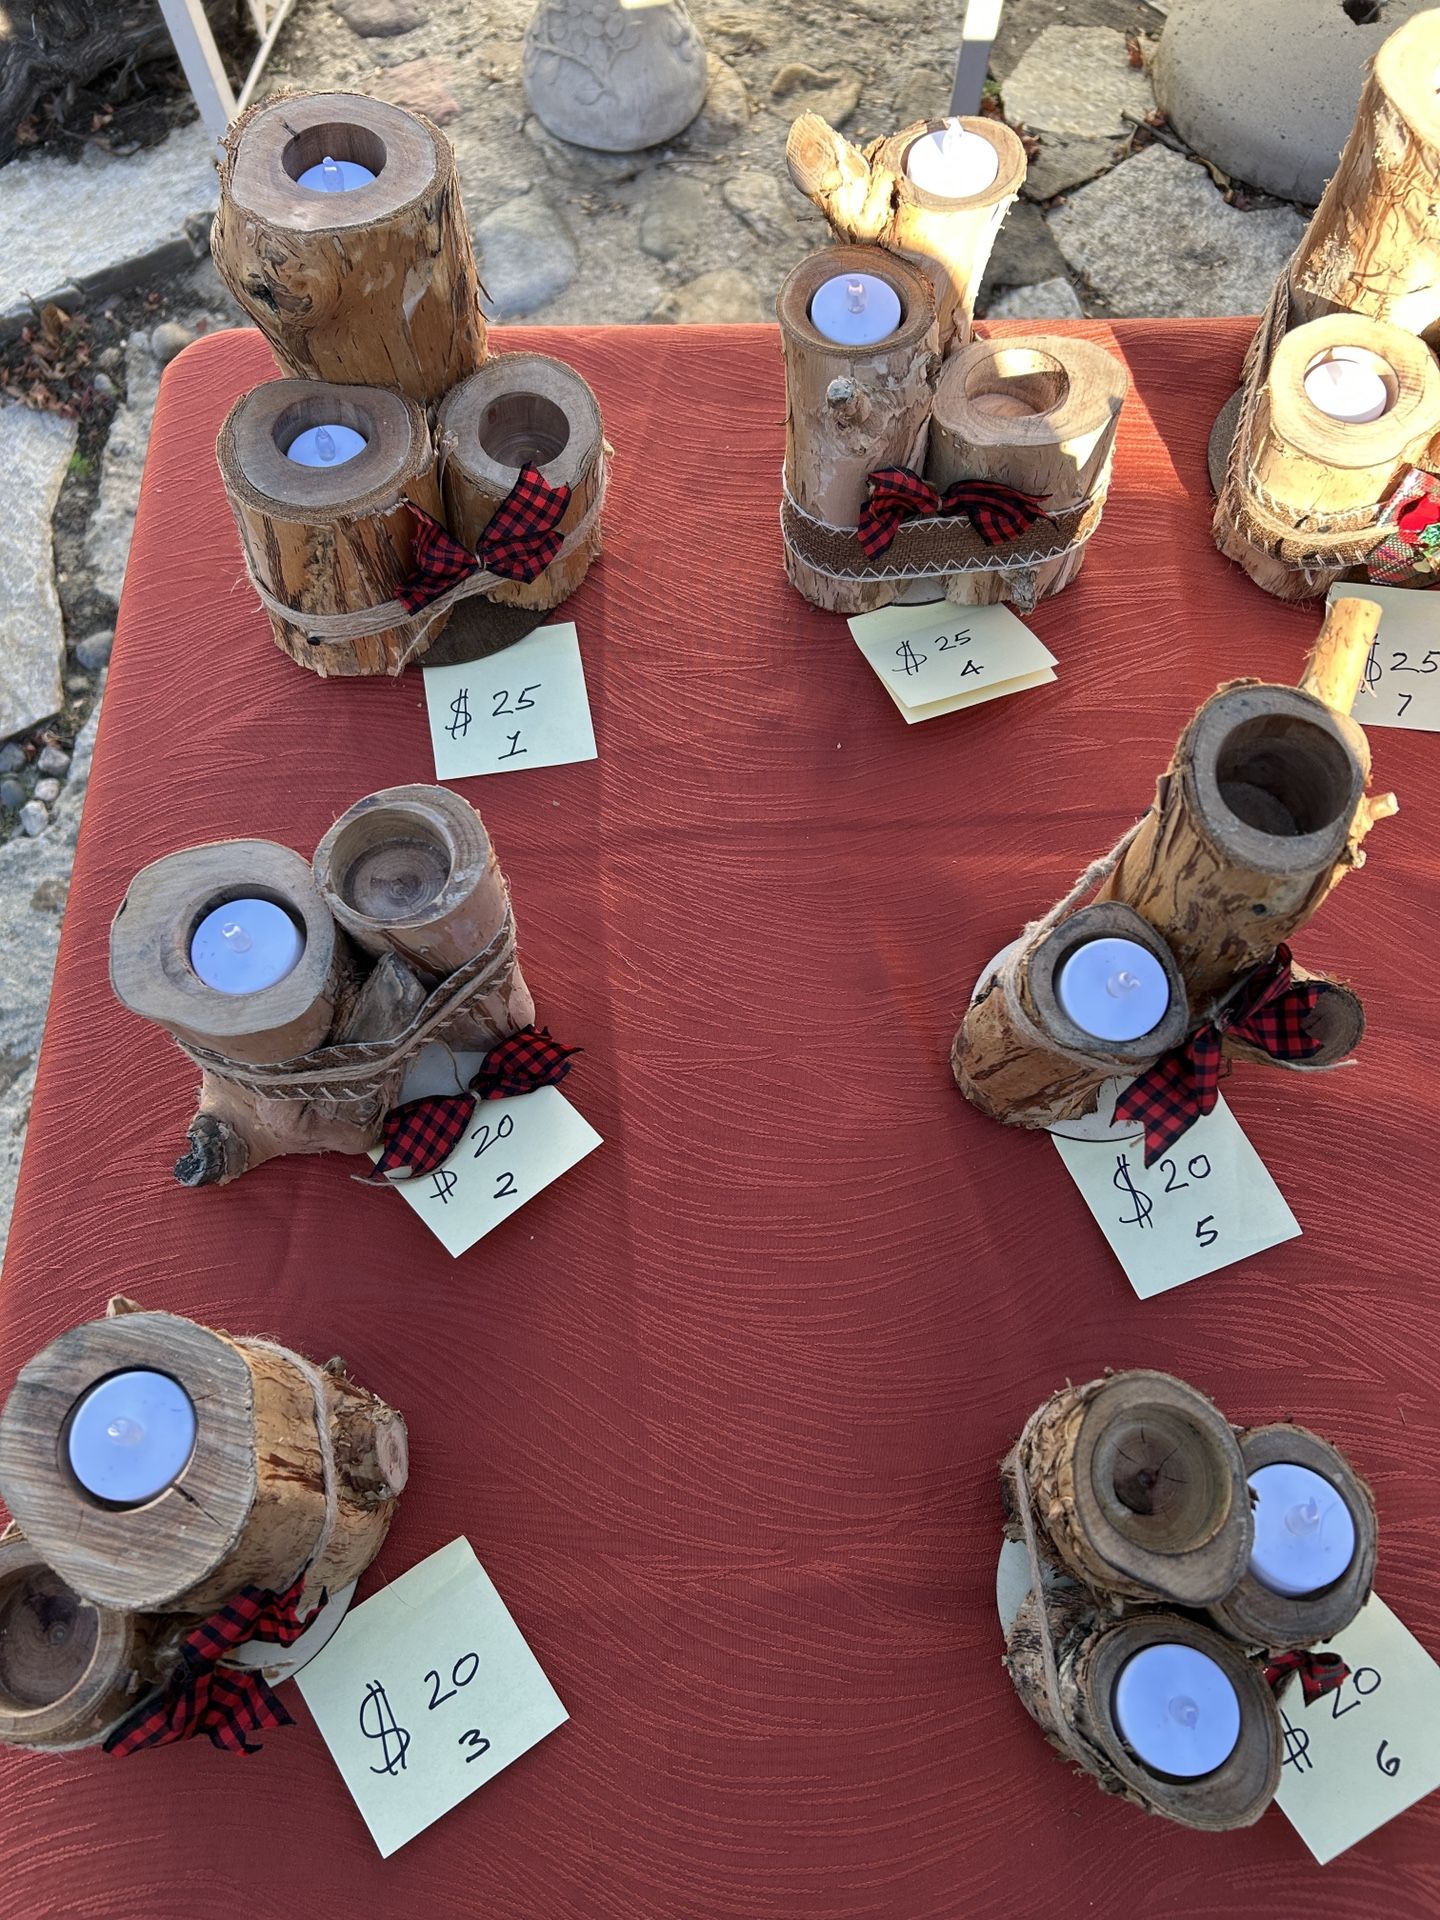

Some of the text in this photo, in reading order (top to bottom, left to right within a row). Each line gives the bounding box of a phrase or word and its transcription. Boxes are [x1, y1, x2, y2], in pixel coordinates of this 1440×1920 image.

[934, 628, 972, 652] 25
[960, 660, 984, 676] 4
[445, 684, 541, 740] $ 25
[1398, 693, 1413, 716] 7
[498, 731, 527, 760] 1
[471, 1114, 514, 1158] 20
[493, 1172, 517, 1199] 2
[1196, 1215, 1218, 1247] 5
[424, 1653, 479, 1710] 20
[459, 1729, 490, 1763] 3
[1376, 1740, 1400, 1777] 6
